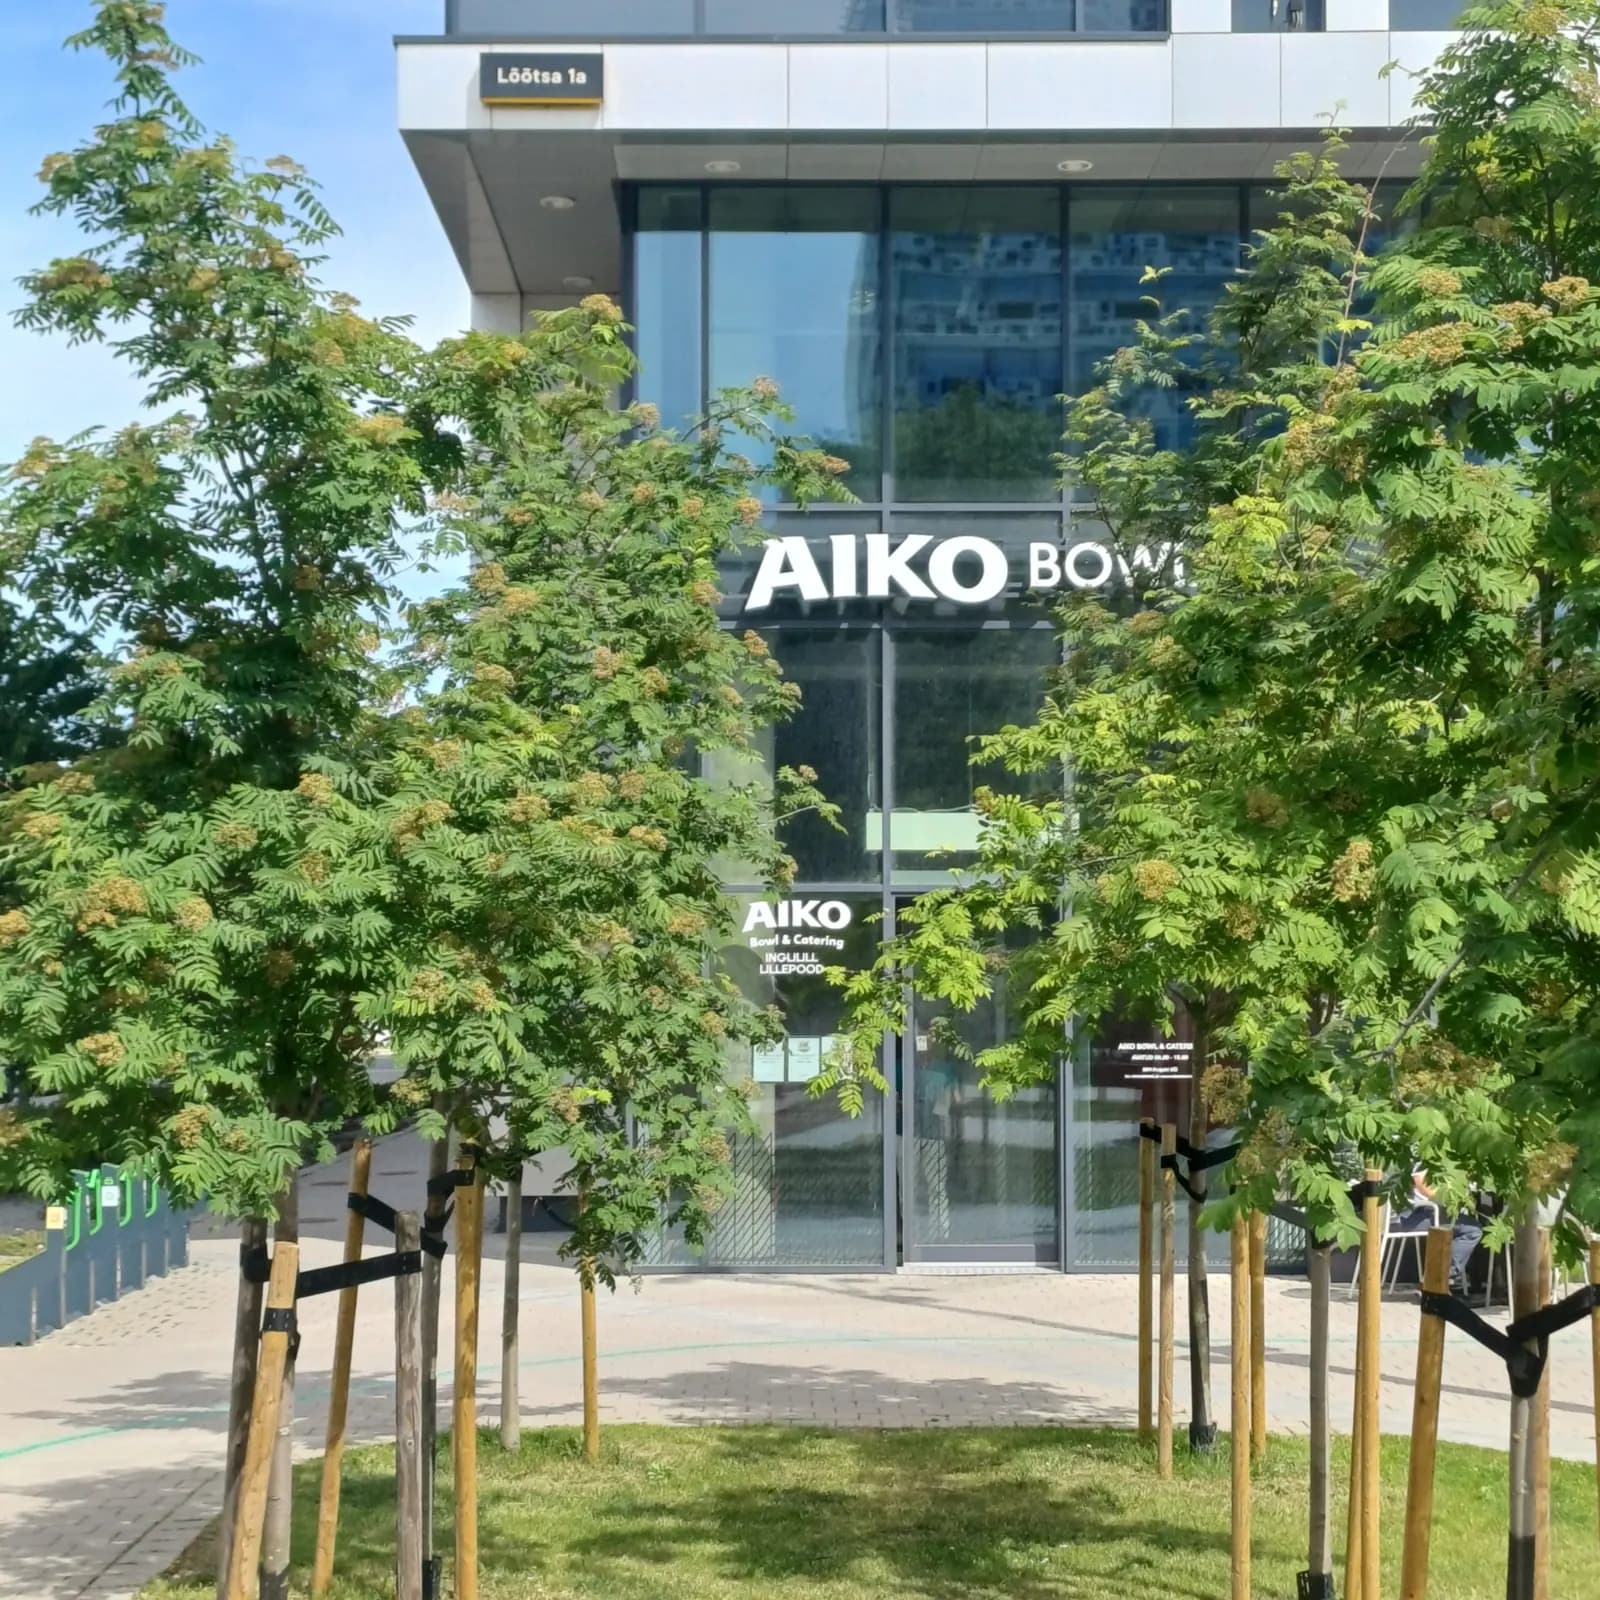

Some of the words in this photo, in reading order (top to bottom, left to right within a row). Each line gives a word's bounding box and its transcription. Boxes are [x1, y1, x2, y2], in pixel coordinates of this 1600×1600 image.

[497, 67, 562, 84] Lõõtsa
[567, 68, 587, 84] 1a
[744, 533, 1009, 612] AIKO
[742, 900, 852, 933] AIKO
[749, 934, 779, 948] Bowl
[781, 934, 791, 946] &
[793, 934, 845, 950] Catering
[760, 964, 825, 974] LILLEPOOD
